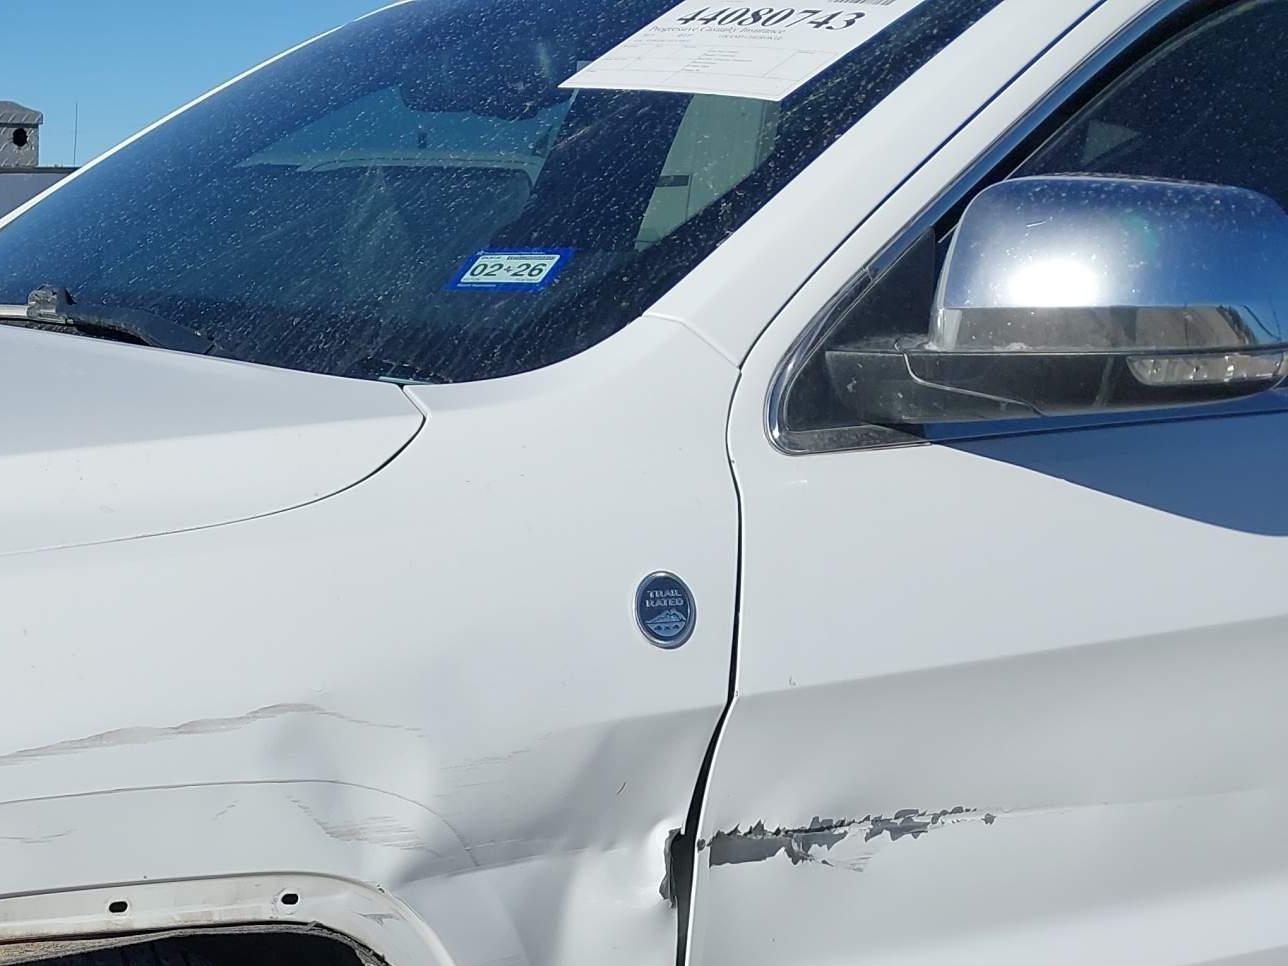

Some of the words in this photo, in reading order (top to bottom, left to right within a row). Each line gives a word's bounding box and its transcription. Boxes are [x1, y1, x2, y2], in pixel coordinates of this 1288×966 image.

[676, 7, 866, 31] 44080743
[469, 263, 504, 277] 02
[510, 263, 547, 277] 26
[647, 589, 682, 599] TRAIL
[645, 598, 684, 608] RATED
